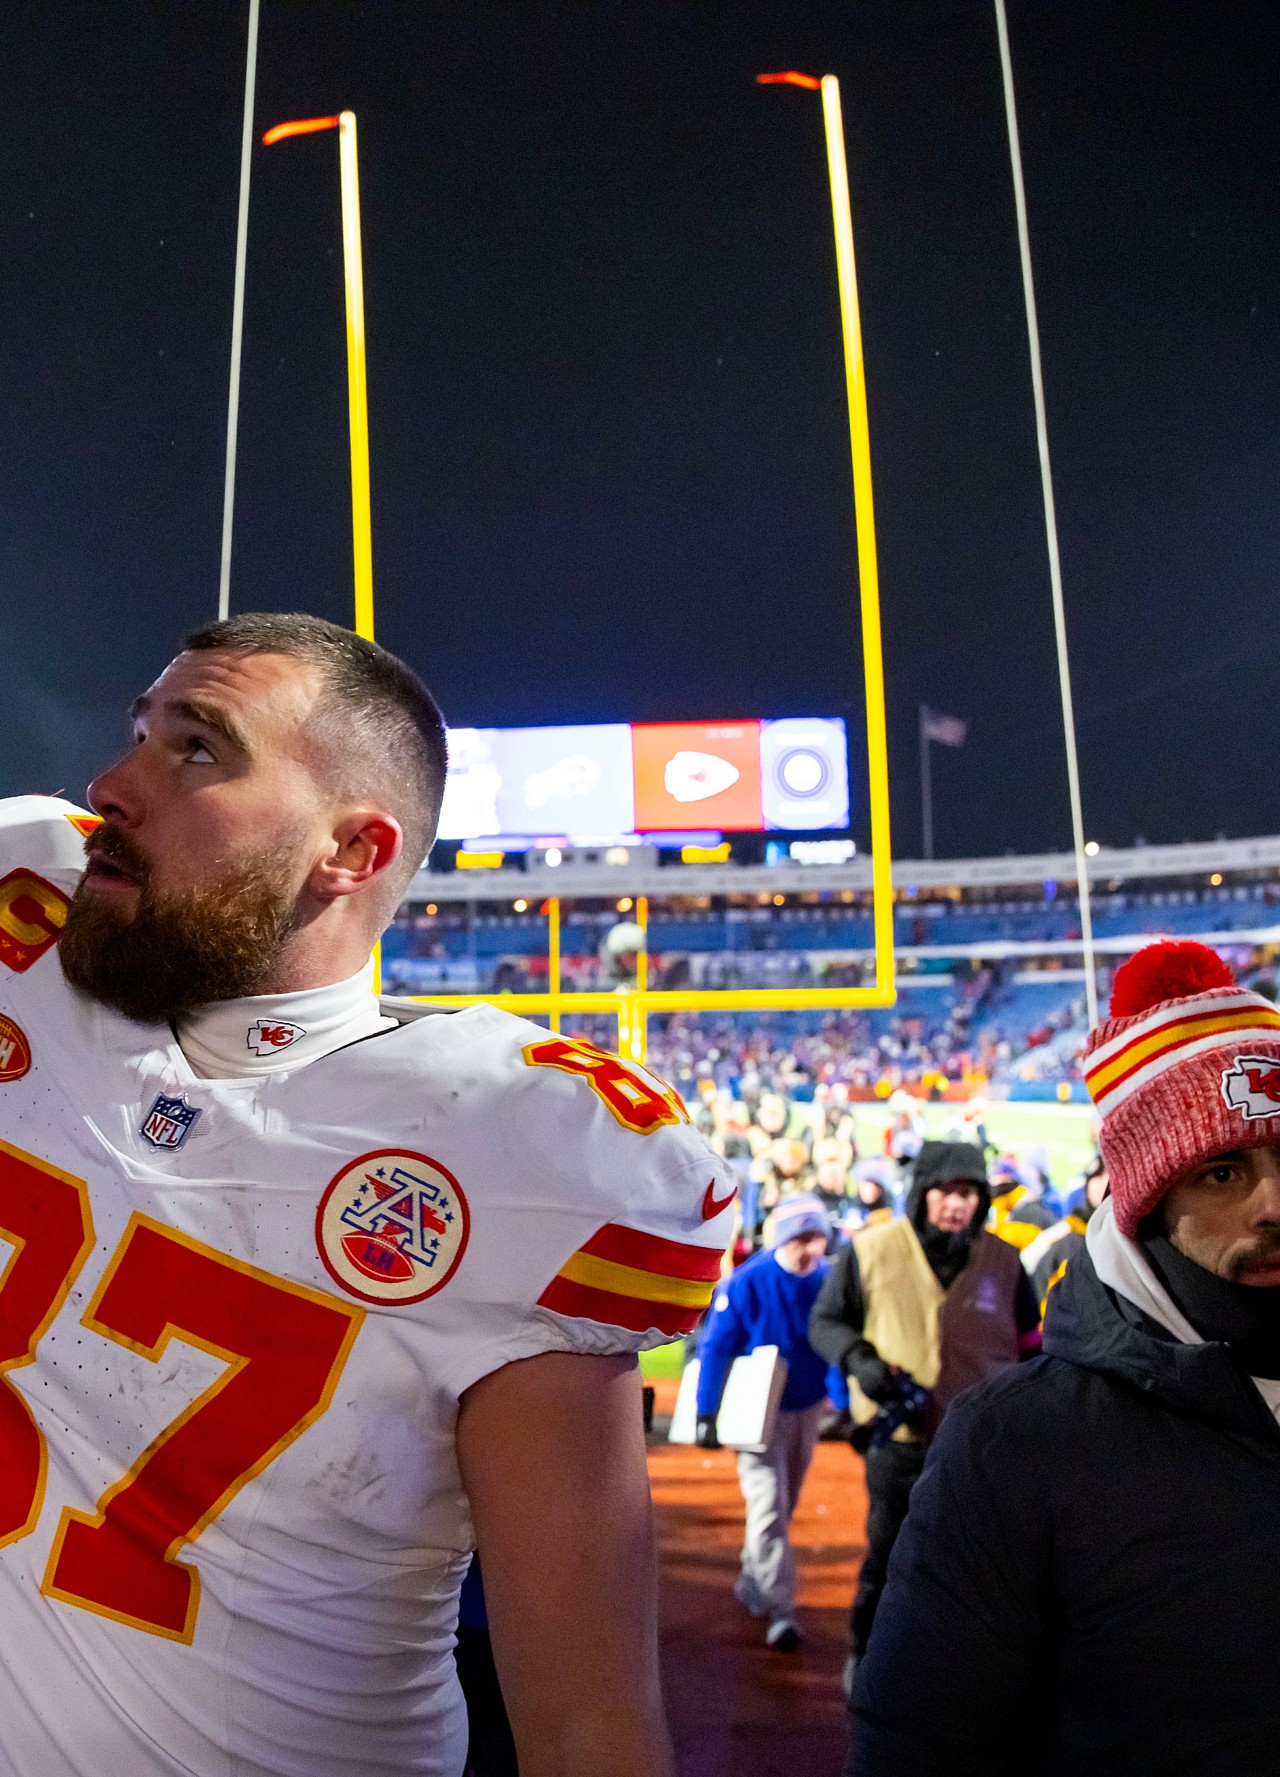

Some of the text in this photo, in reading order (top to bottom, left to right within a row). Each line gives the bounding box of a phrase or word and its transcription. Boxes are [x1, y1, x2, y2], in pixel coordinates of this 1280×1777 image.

[260, 1026, 294, 1047] KC
[146, 1113, 180, 1144] NFL
[340, 1168, 440, 1268] A
